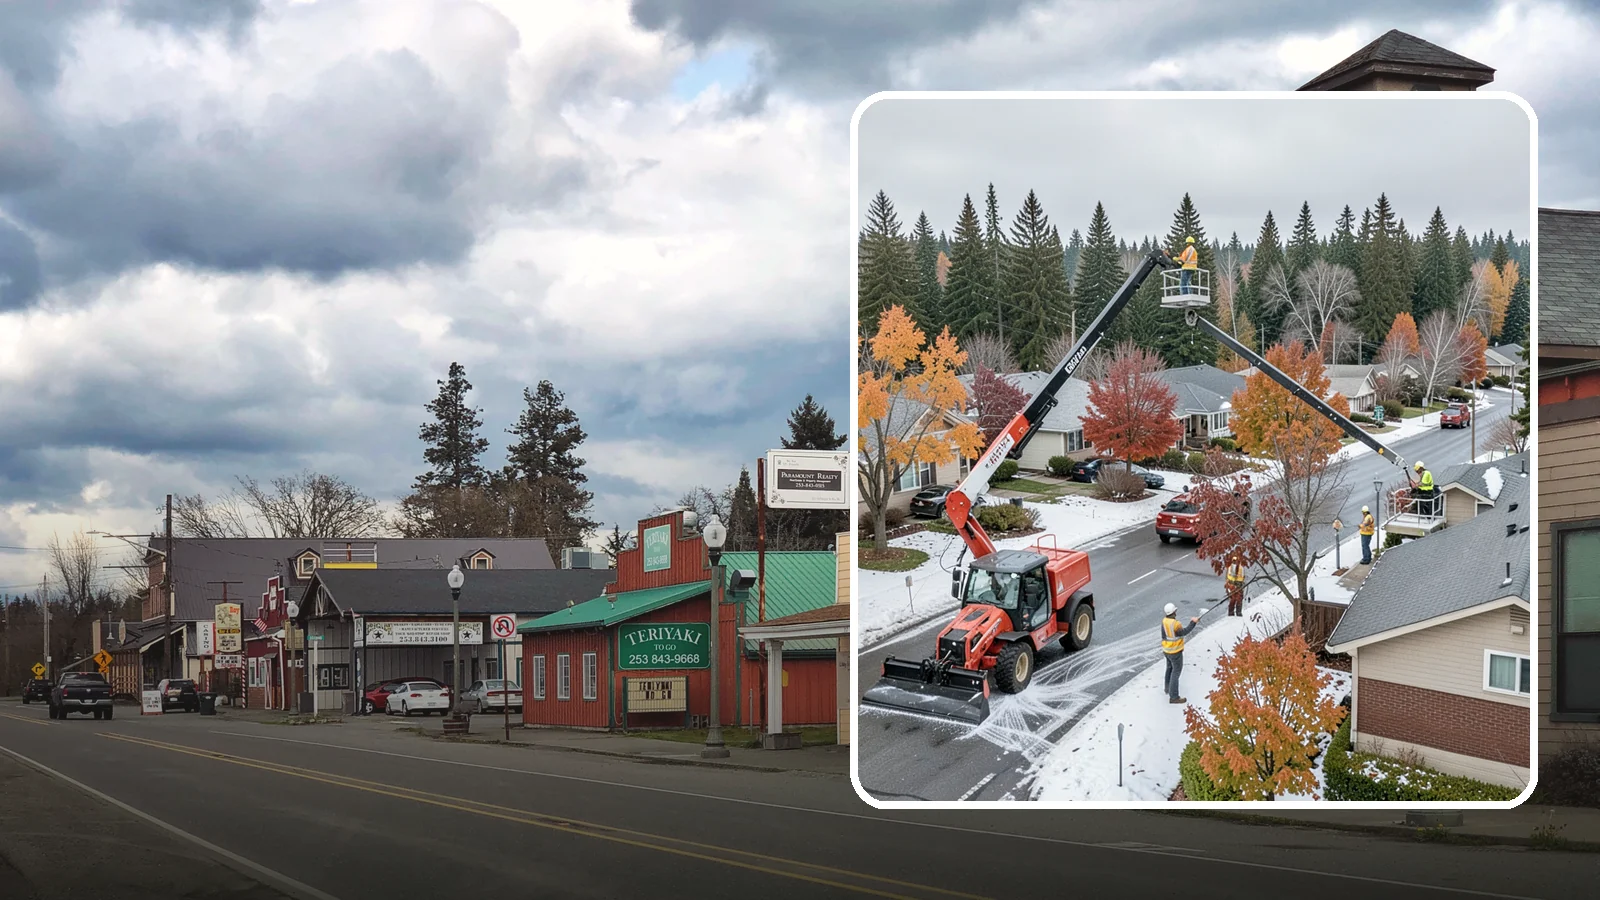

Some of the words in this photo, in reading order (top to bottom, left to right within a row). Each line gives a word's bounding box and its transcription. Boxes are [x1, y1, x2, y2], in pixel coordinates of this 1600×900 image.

[817, 472, 839, 480] REALTY
[625, 627, 702, 646] TERIYAKI
[629, 654, 649, 664] 253
[651, 653, 700, 664] 843-9668
